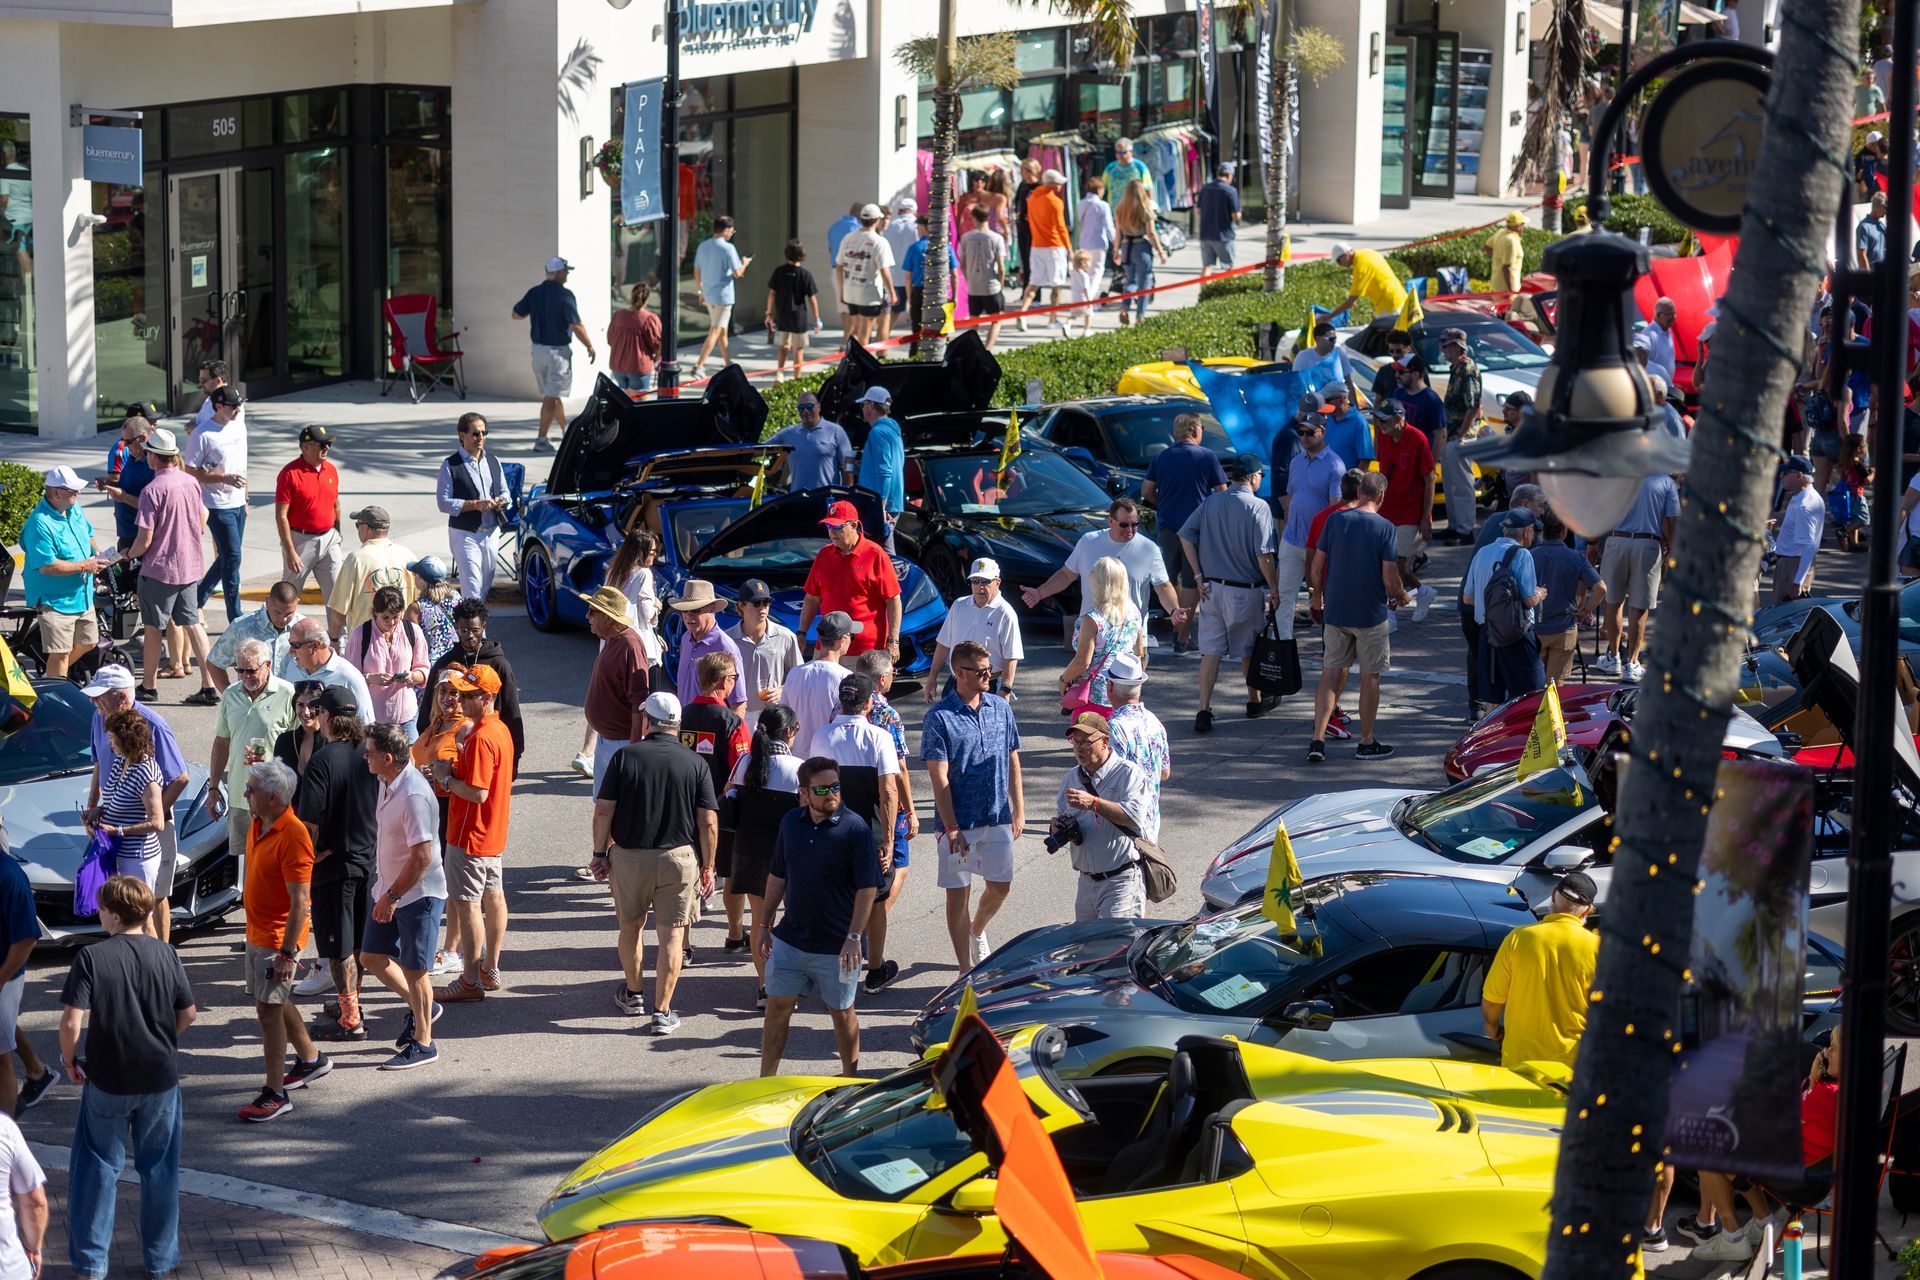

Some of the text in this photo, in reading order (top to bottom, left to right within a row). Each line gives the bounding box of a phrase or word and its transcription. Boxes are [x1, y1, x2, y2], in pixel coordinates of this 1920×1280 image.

[677, 0, 819, 35] bluemercury
[212, 117, 236, 137] 505
[635, 94, 649, 176] PLAY
[86, 145, 136, 161] bluemercury
[1689, 157, 1756, 176] aven
